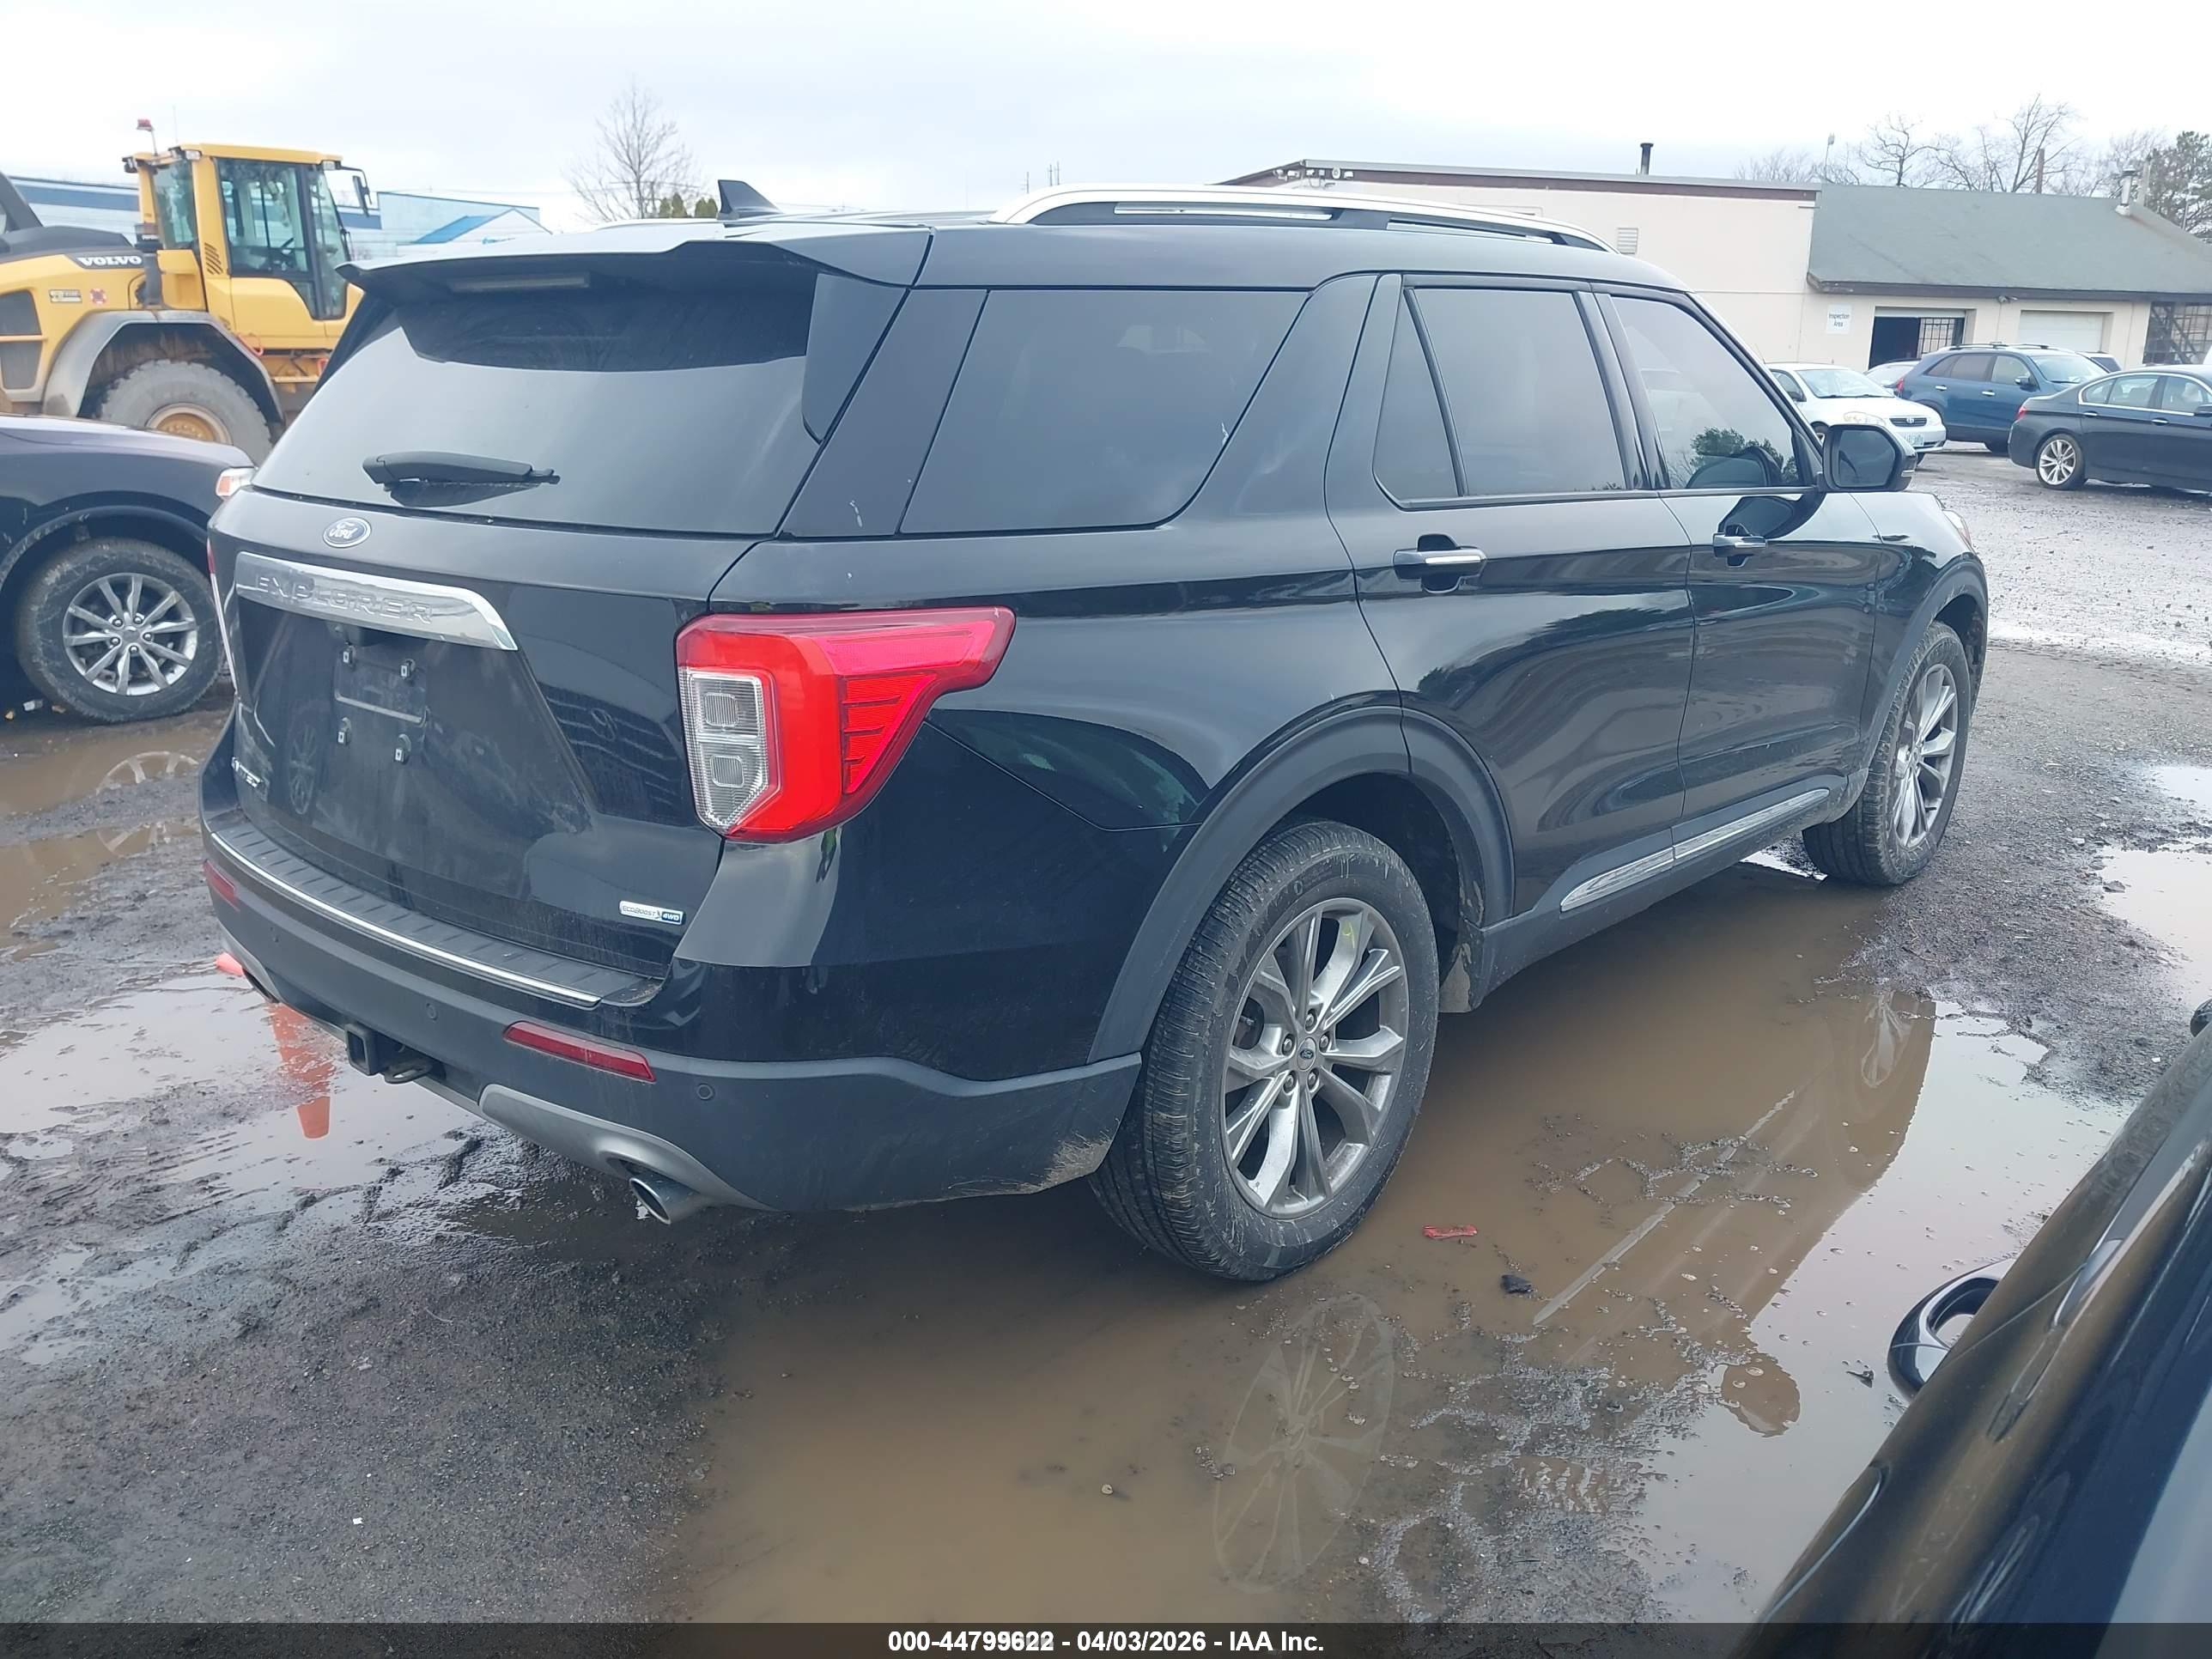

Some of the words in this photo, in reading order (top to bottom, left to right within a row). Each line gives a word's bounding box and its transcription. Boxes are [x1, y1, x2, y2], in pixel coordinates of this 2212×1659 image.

[77, 256, 143, 266] VOLVO
[329, 520, 358, 540] Ford
[258, 576, 432, 624] EXPLORER
[662, 912, 680, 922] 4WD
